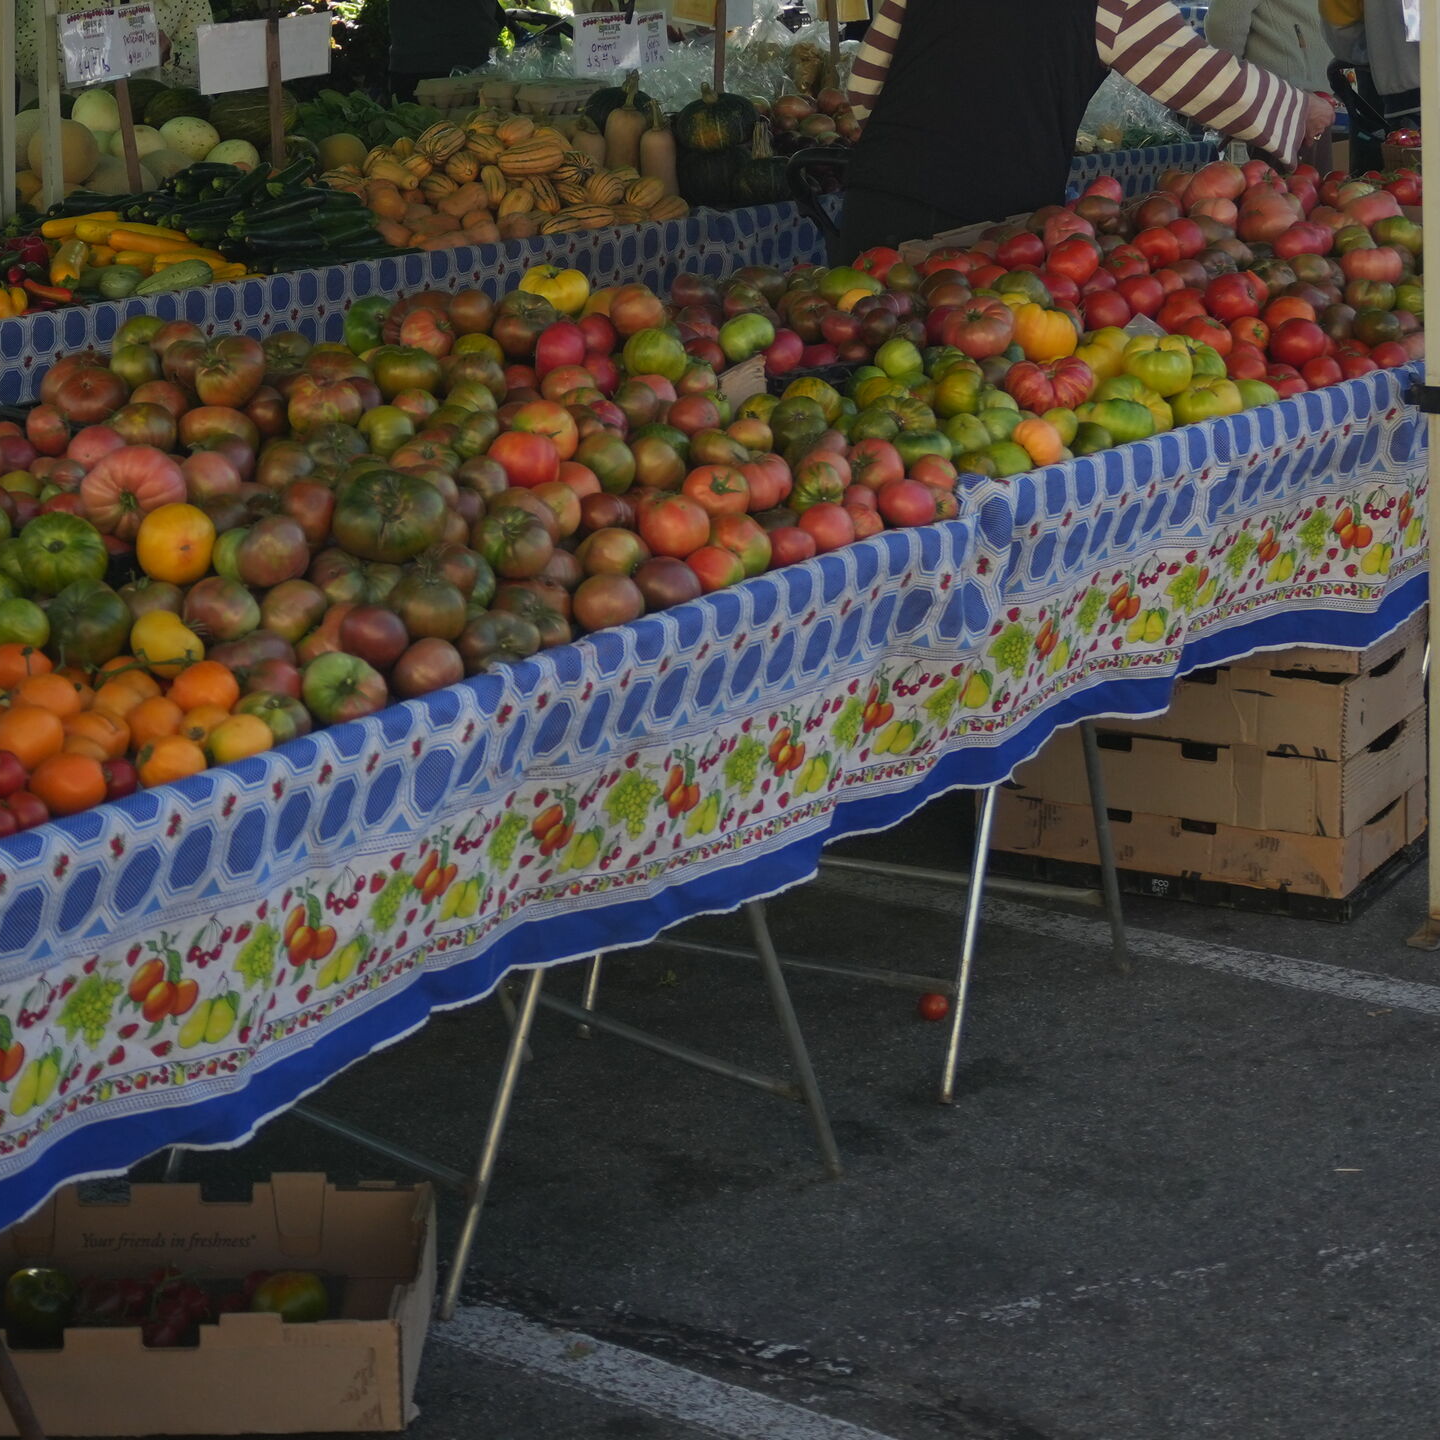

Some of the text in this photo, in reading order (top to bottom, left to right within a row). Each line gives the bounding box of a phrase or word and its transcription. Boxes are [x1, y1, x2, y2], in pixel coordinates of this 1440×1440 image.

[81, 1233, 111, 1248] Your
[113, 1231, 166, 1252] friends
[170, 1233, 186, 1248] in
